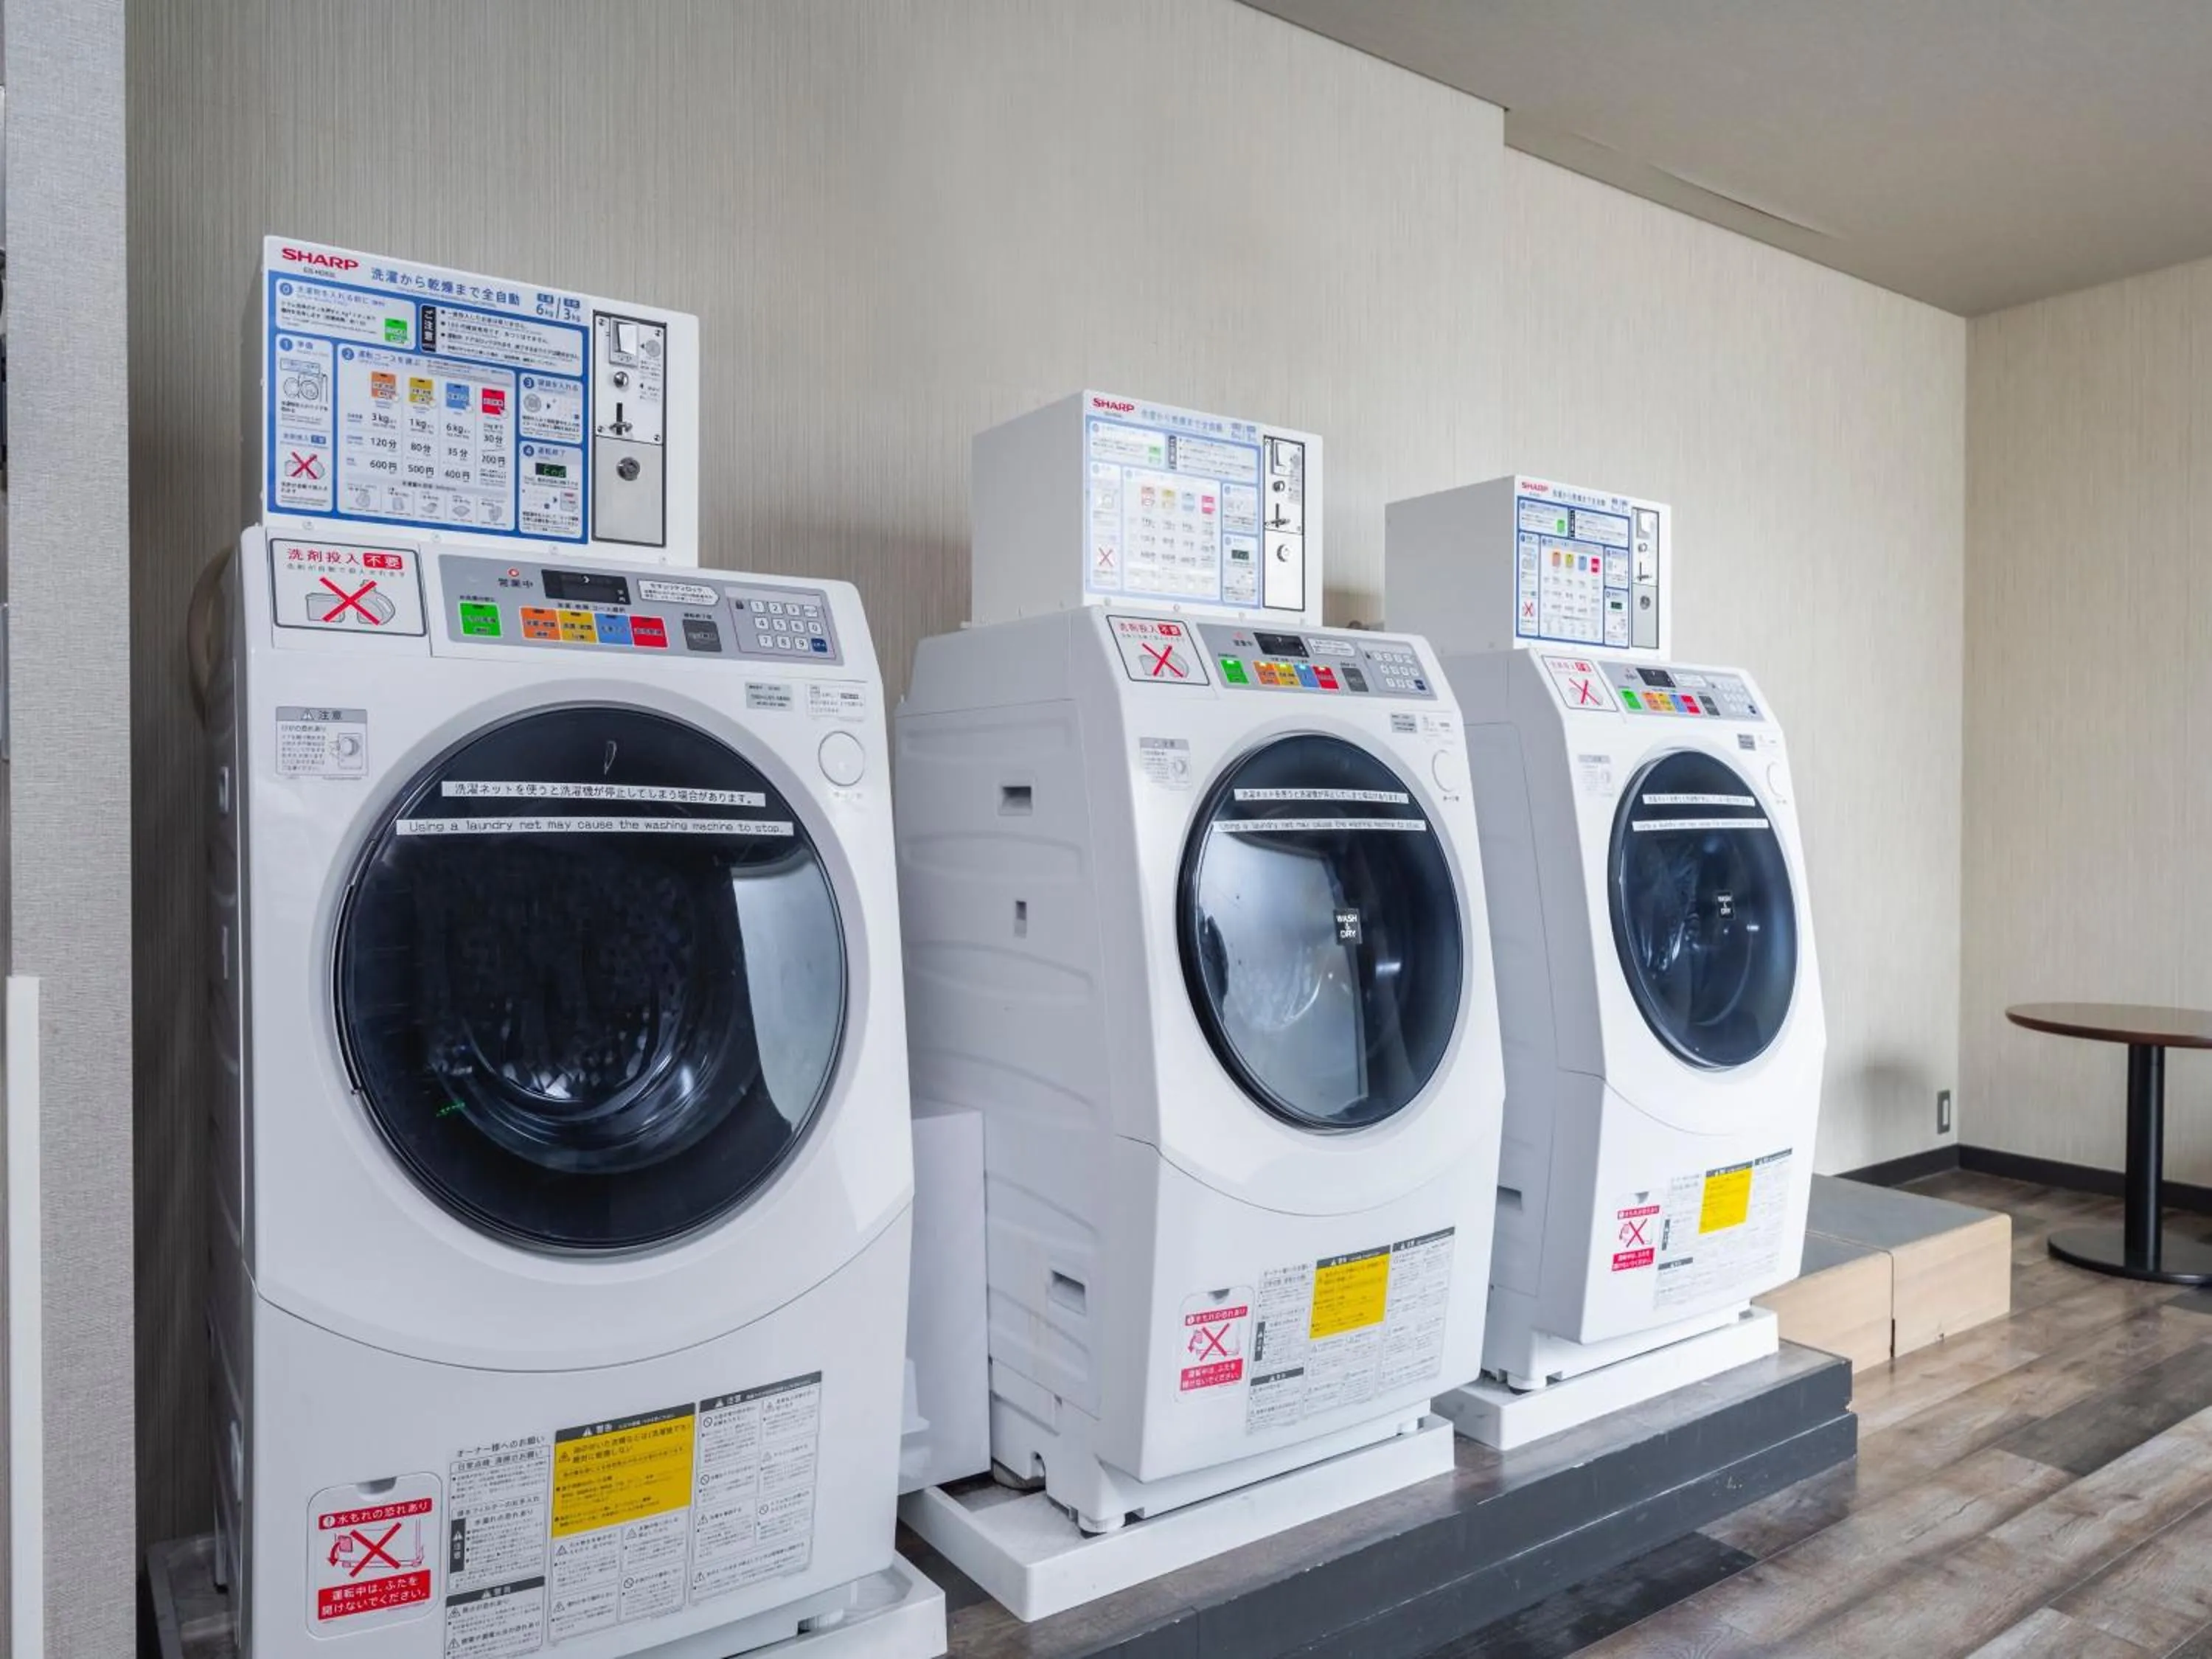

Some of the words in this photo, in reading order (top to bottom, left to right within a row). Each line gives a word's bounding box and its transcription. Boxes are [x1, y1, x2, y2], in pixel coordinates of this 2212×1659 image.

[282, 248, 359, 271] SHARP
[371, 267, 521, 307] 洗濯から乾燥まで全自動
[1093, 397, 1135, 413] SHARP
[287, 548, 360, 565] 洗剤投入
[367, 555, 401, 568] 不要
[455, 783, 752, 804] 洗濯ネットを使うと洗濯機が停止してしまう場合があります。
[409, 821, 445, 832] Using
[451, 822, 459, 830] a
[466, 820, 514, 830] laundry
[519, 819, 542, 830] net
[548, 820, 572, 831] may
[577, 820, 613, 830] cause
[619, 819, 640, 830] the
[644, 820, 688, 832] washing
[692, 821, 734, 831] machine
[739, 822, 752, 832] to
[1336, 914, 1357, 922] WASH
[1340, 930, 1356, 939] DRY
[337, 1500, 428, 1524] 水もれの恐れあり
[321, 1590, 425, 1615] 開けないでください。
